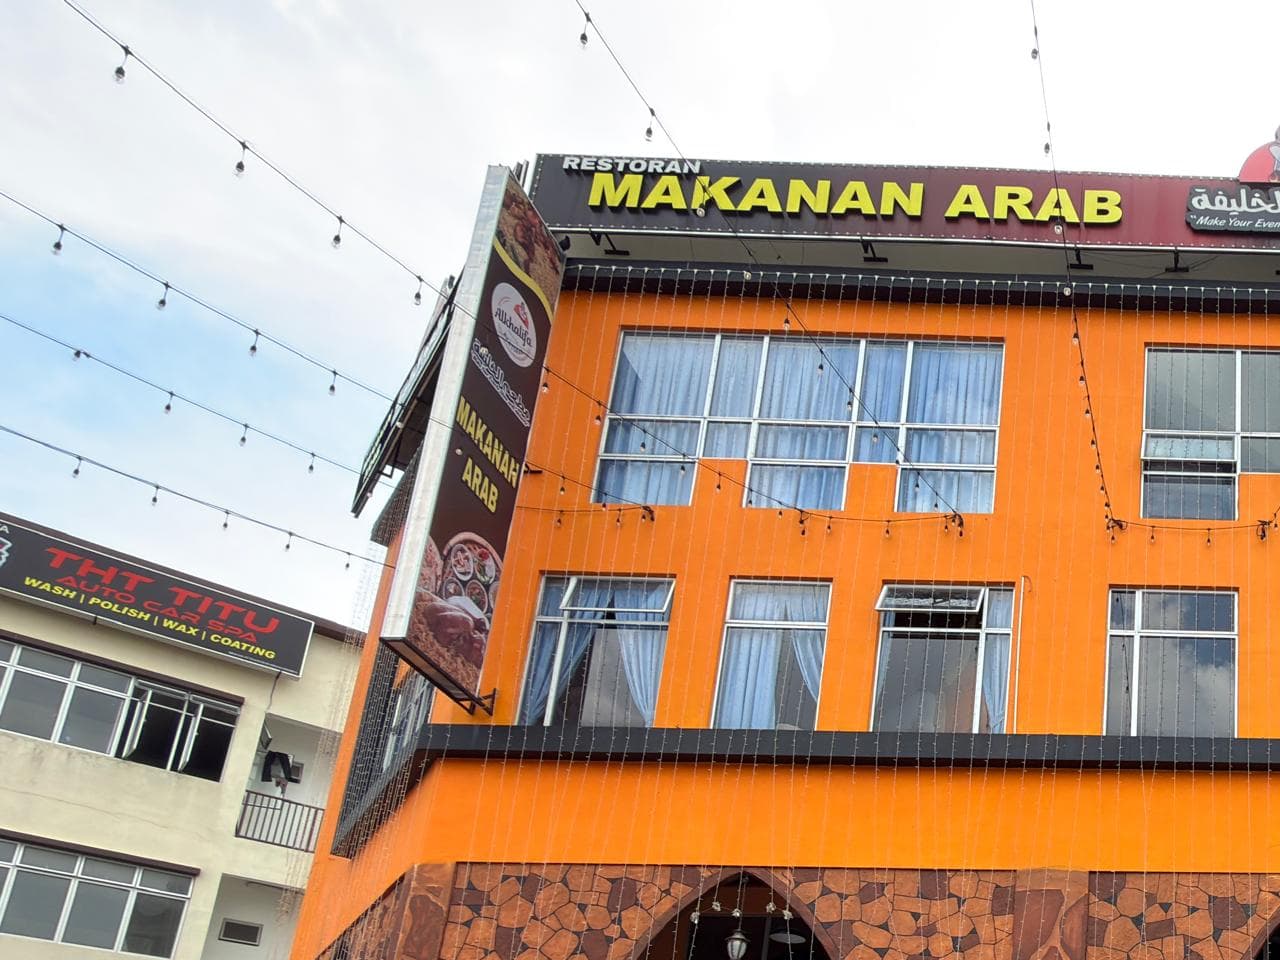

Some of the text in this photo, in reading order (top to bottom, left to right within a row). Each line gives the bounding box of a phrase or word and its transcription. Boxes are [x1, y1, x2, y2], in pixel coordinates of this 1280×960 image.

[563, 156, 701, 174] RESTORAN
[588, 172, 1123, 225] MAKANAN ARAB
[1228, 217, 1252, 228] Your
[494, 307, 532, 347] Alkhalifa
[455, 397, 519, 489] MAKANAN
[461, 457, 498, 513] ARAB
[24, 576, 76, 599] WASH
[88, 596, 151, 622] POLISH
[163, 617, 199, 637] WAX
[210, 633, 275, 660] COATING
[46, 546, 280, 634] THT TITU
[55, 575, 257, 643] AUTO CAR SPA
